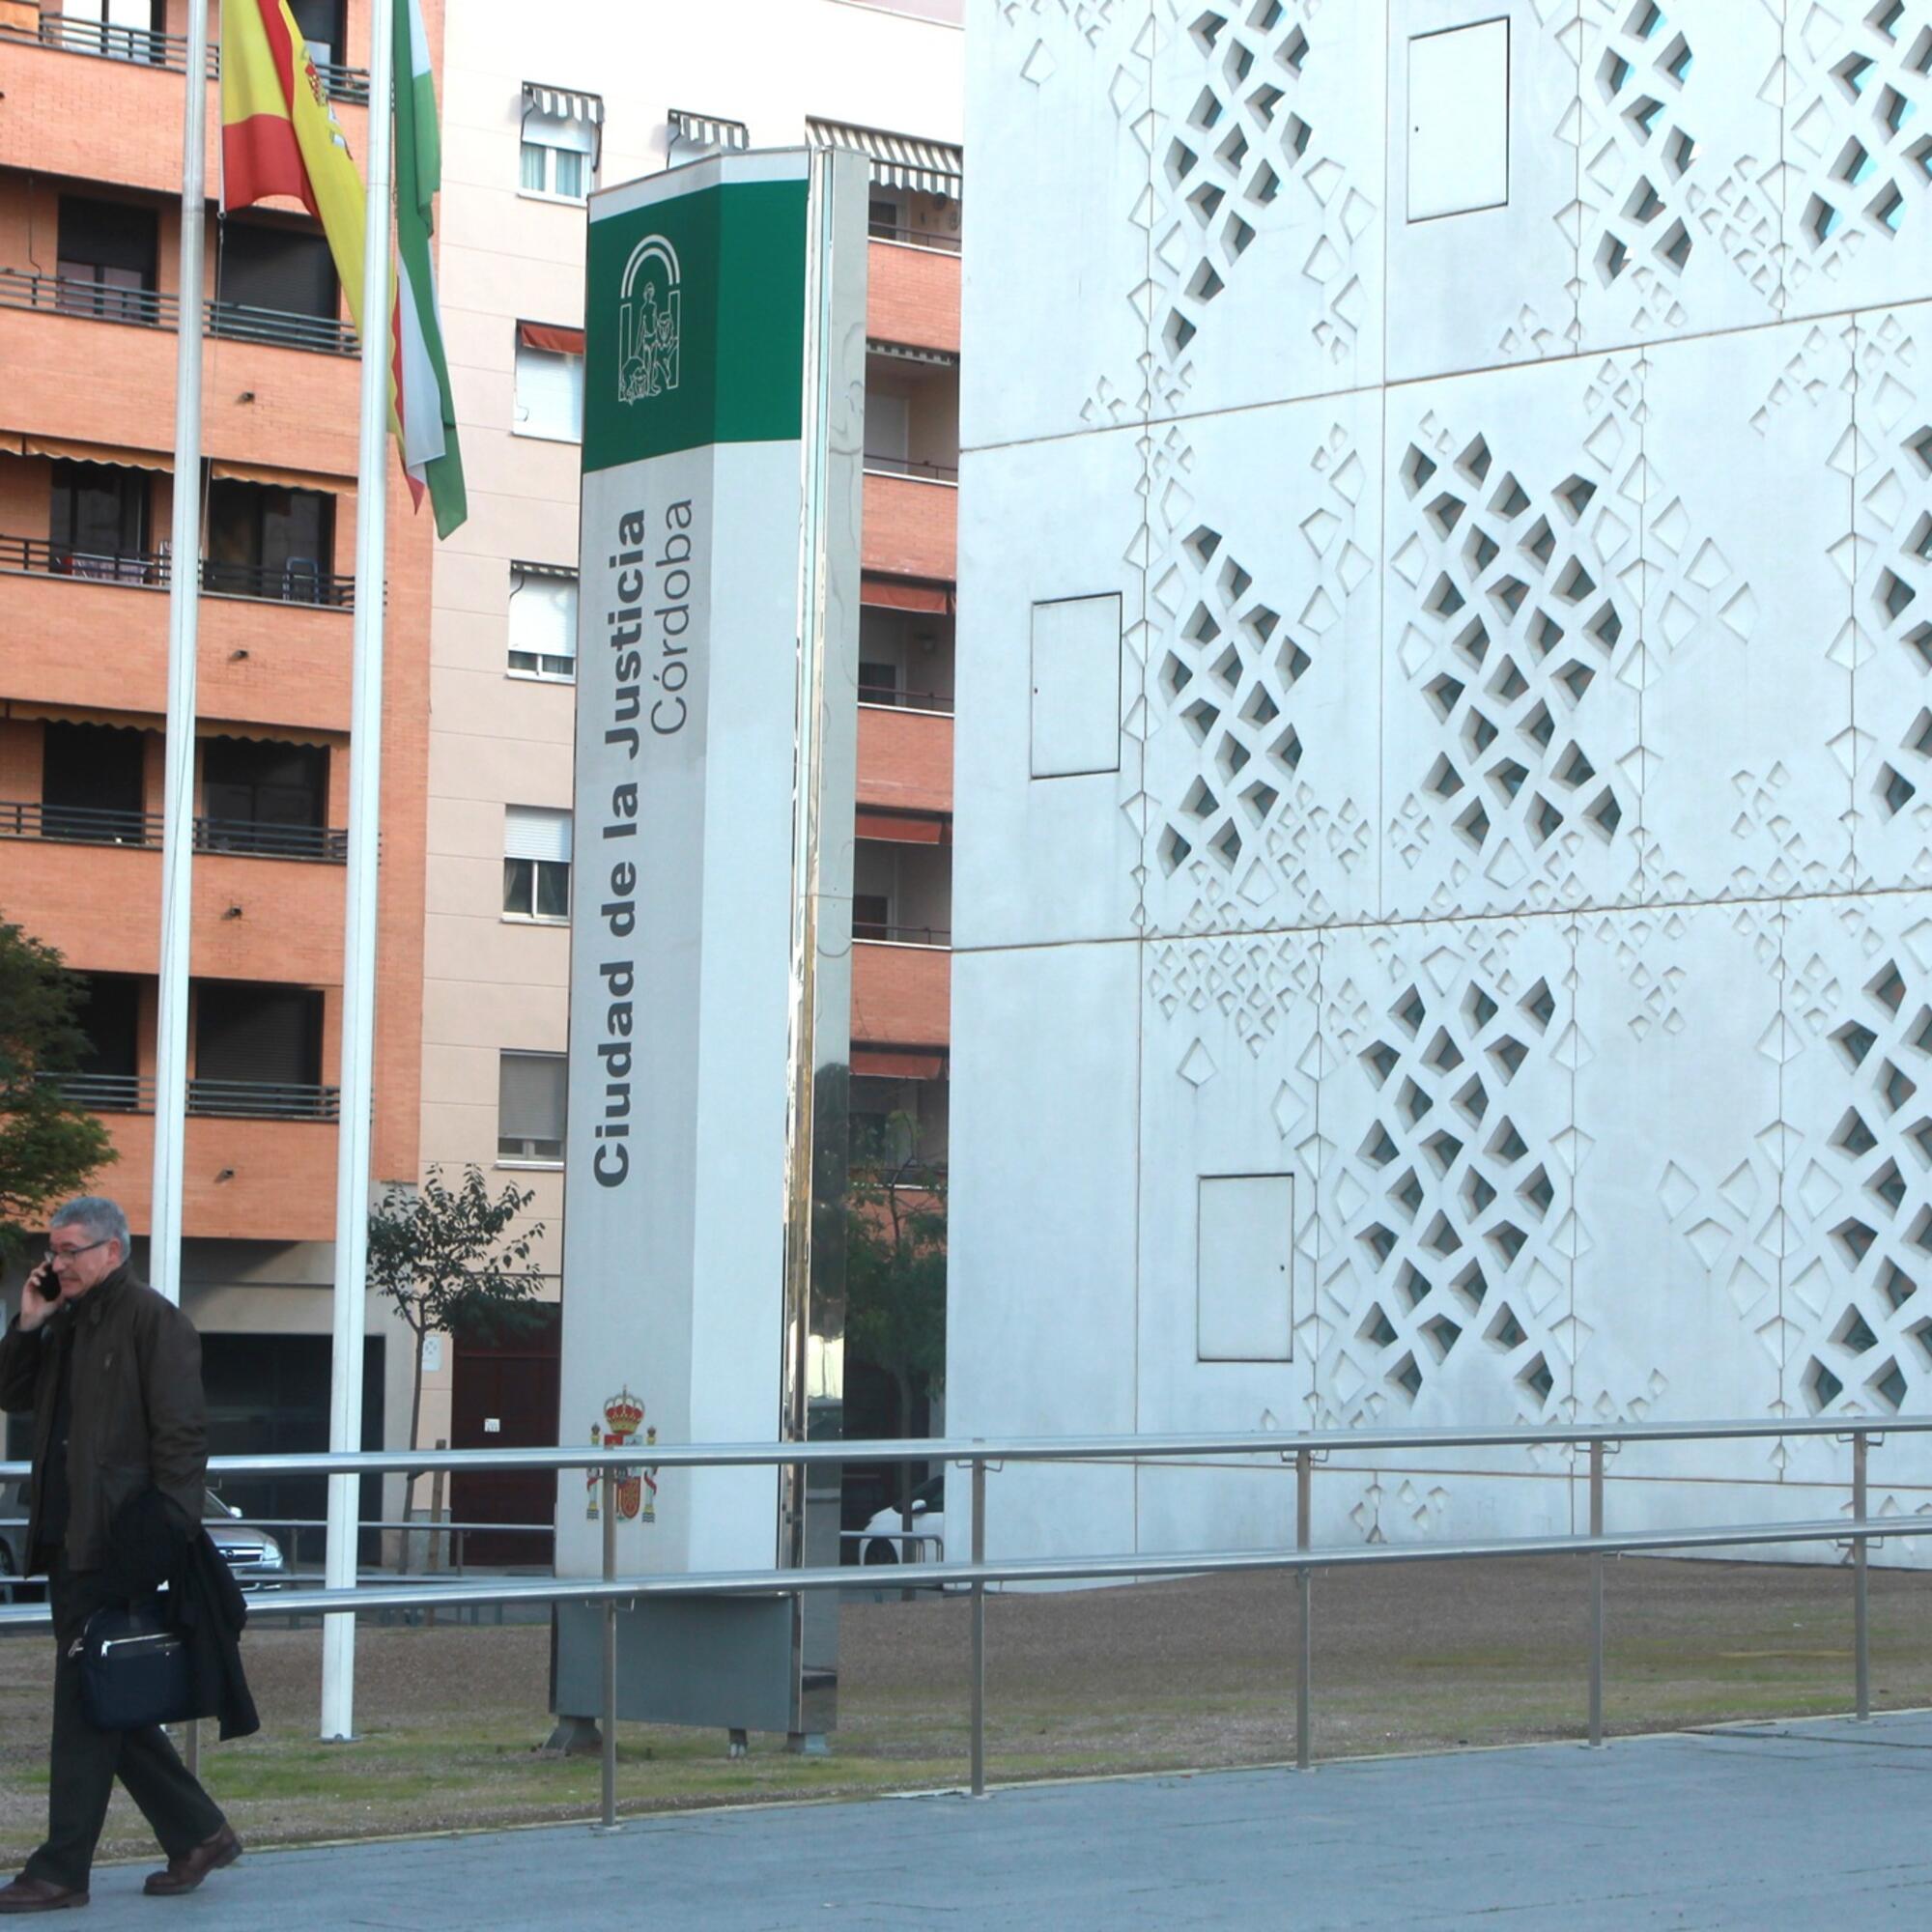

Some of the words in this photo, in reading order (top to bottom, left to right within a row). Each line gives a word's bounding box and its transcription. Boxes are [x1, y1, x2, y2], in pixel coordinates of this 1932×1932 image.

[605, 509, 645, 760] Justicia
[650, 498, 693, 735] Córdoba
[601, 862, 638, 938] de
[602, 782, 639, 839] la
[593, 960, 635, 1188] Ciudad
